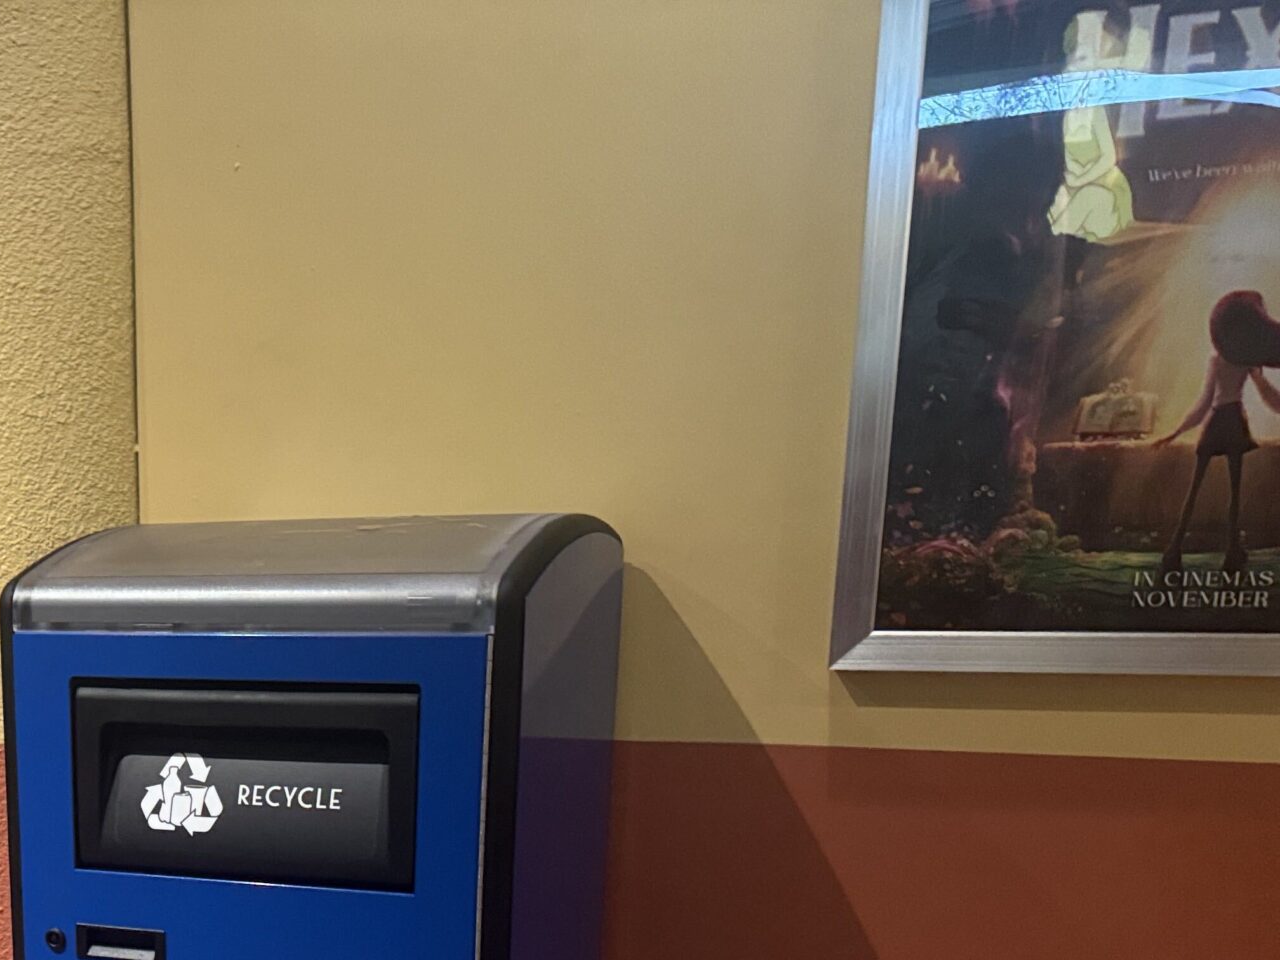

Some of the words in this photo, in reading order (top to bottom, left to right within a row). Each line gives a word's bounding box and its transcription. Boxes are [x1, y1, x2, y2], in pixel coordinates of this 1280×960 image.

[1133, 570, 1154, 588] IN
[1163, 570, 1275, 588] CINEMAS
[1131, 590, 1270, 608] NOVEMBER
[237, 784, 343, 810] RECYCLE
